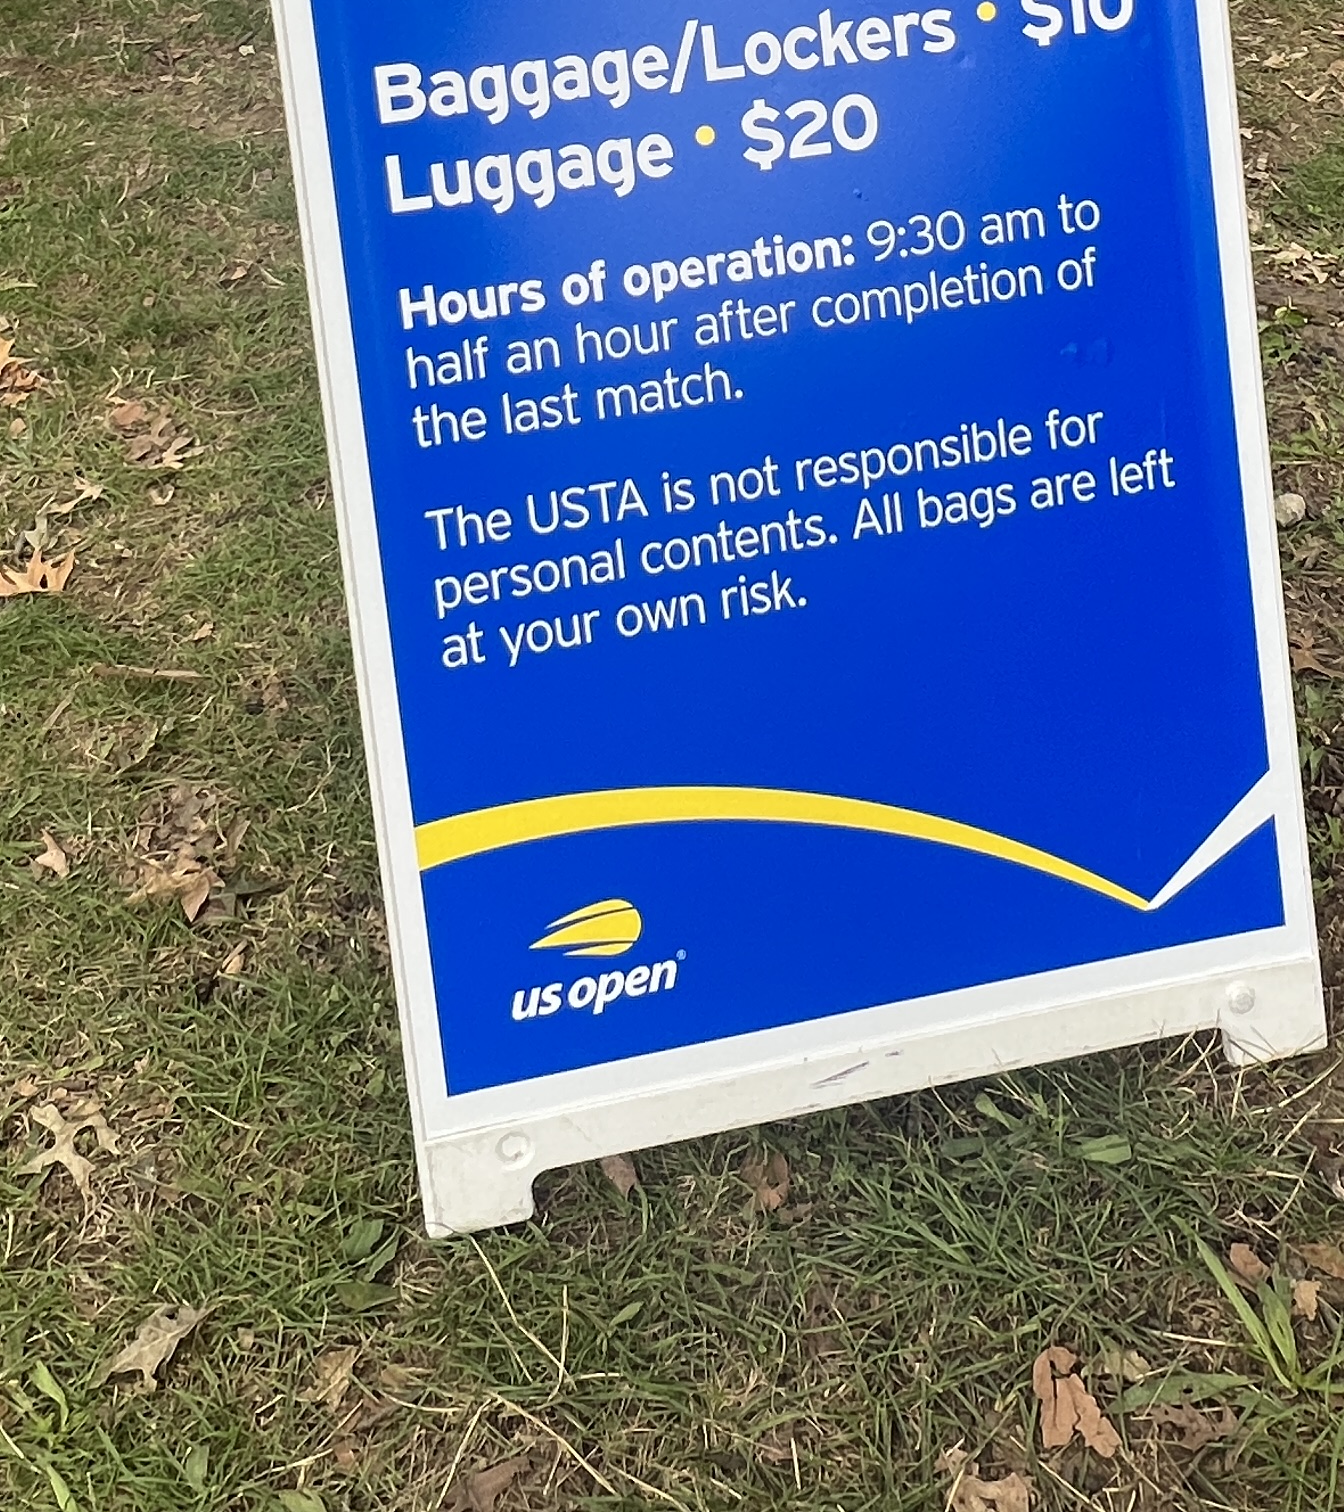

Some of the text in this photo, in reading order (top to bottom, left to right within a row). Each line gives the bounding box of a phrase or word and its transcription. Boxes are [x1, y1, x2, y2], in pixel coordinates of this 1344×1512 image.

[374, 8, 956, 125] Baggage/Lockers
[385, 93, 879, 214] Luggage $20
[399, 194, 1100, 330] Hours of operation: 9:30 am to
[406, 246, 1096, 389] half an hour after completion of
[412, 362, 744, 448] the last match.
[424, 408, 1104, 551] The USTA is not responsible for
[434, 448, 1176, 620] personal contents. All bags are left
[442, 570, 807, 668] at your own risk.
[511, 982, 562, 1021] us
